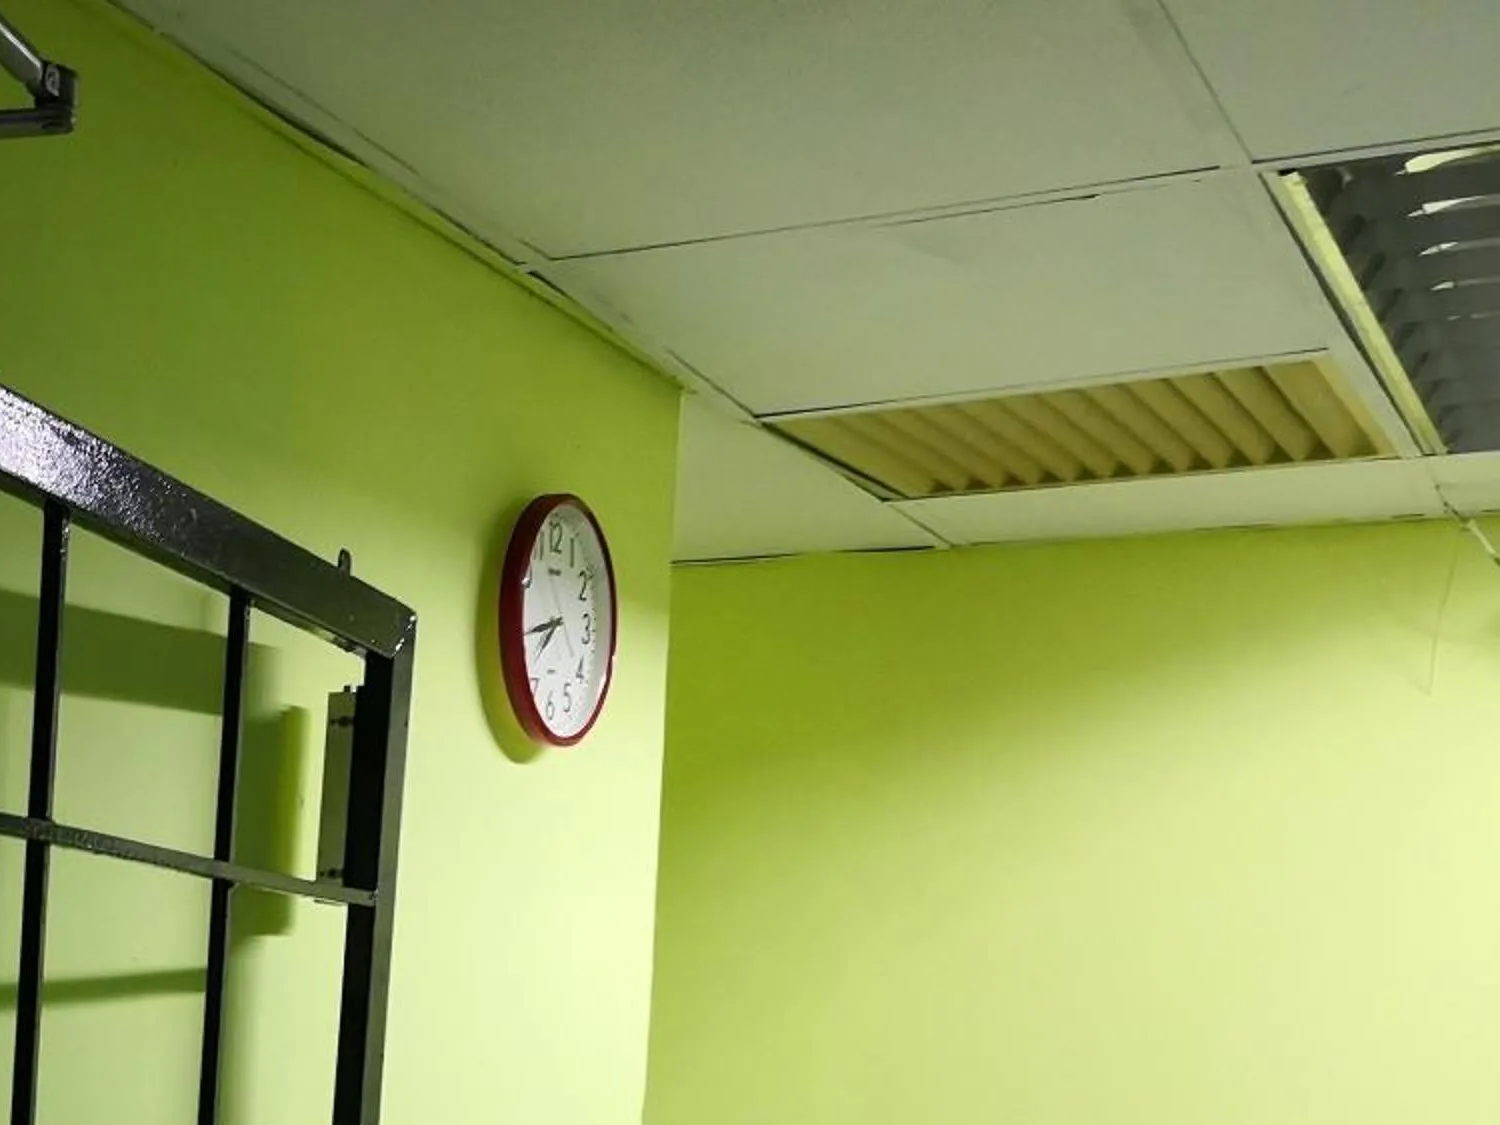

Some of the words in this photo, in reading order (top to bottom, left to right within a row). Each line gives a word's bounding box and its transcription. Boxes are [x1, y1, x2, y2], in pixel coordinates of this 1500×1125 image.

[548, 520, 564, 554] 12
[578, 569, 588, 601] 2
[581, 612, 591, 645] 3
[575, 655, 585, 685] 4
[546, 690, 555, 721] 6
[563, 682, 572, 713] 5
